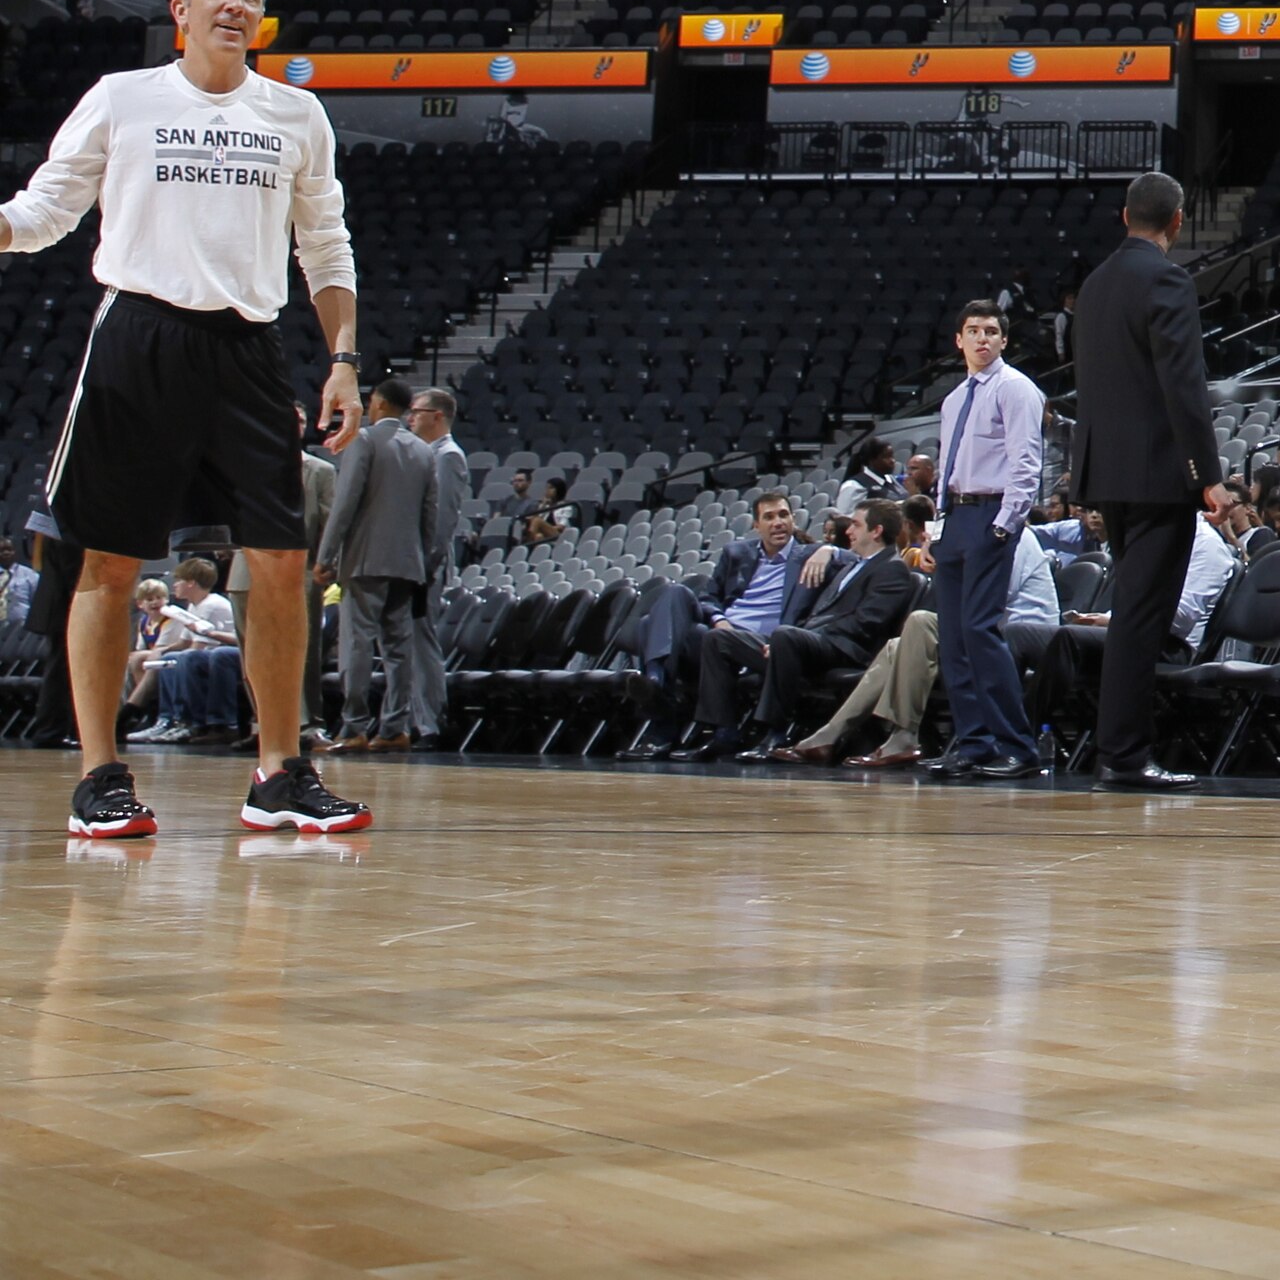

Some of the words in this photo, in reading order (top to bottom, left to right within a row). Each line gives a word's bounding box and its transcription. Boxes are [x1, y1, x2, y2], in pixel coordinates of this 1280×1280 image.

[424, 98, 455, 115] 117
[967, 95, 999, 112] 118
[156, 128, 195, 144] SAN
[202, 130, 282, 152] ANTONIO
[156, 165, 278, 189] BASKETBALL
